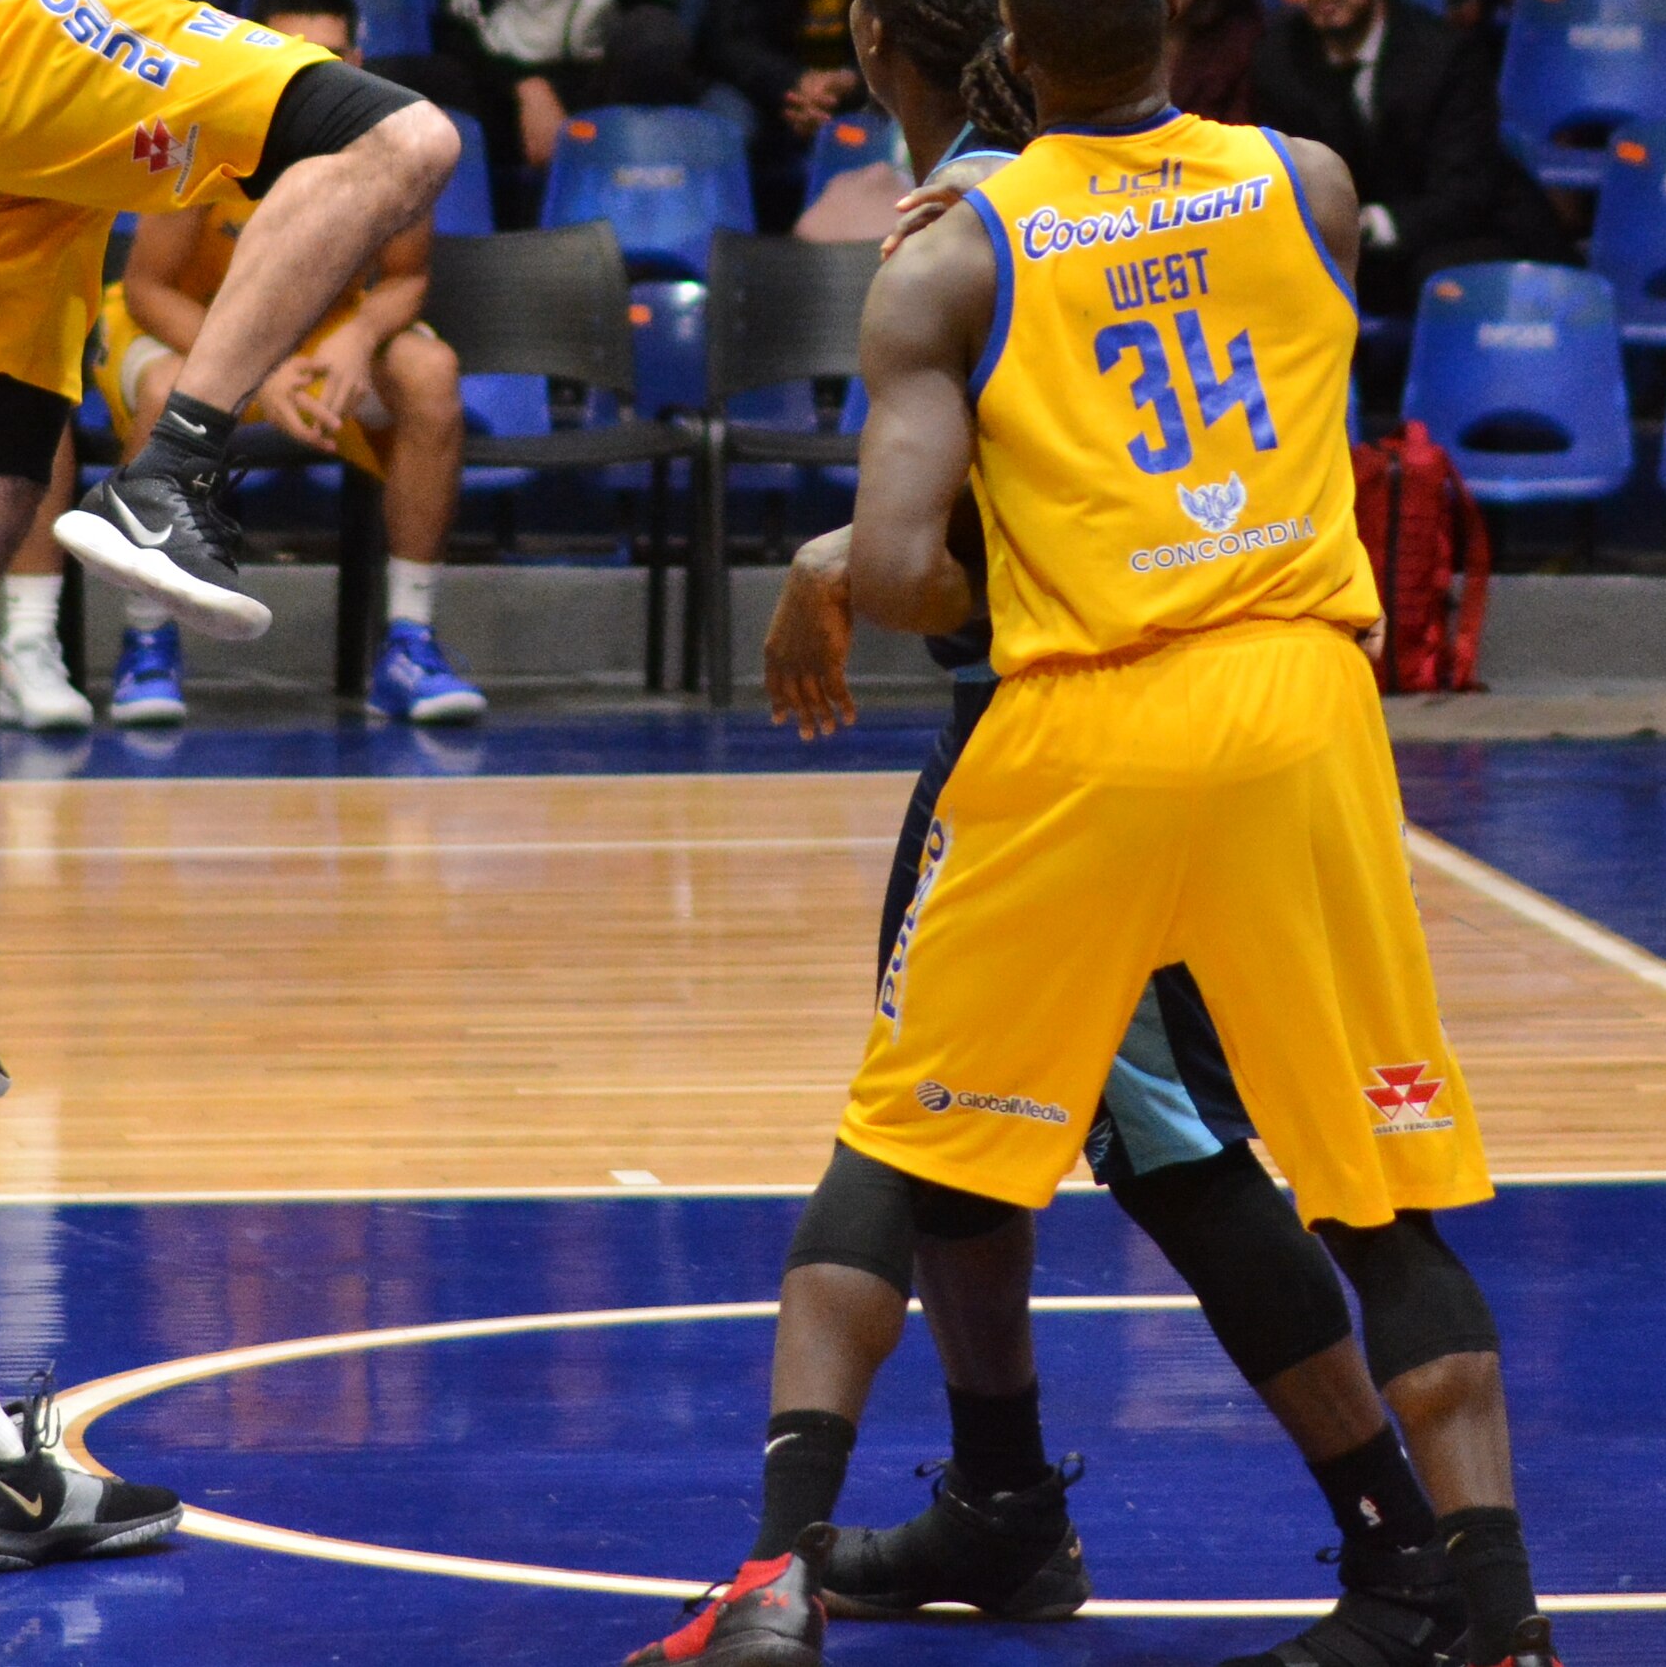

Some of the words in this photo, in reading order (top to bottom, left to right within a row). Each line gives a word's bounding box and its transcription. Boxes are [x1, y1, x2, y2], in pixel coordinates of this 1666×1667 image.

[1018, 207, 1141, 260] Coors
[1147, 177, 1270, 233] LIGHT
[1104, 247, 1209, 312] WEST
[1093, 308, 1279, 476] 34
[1131, 516, 1315, 572] CONCORDIA
[957, 1091, 1068, 1123] GlobalMedia
